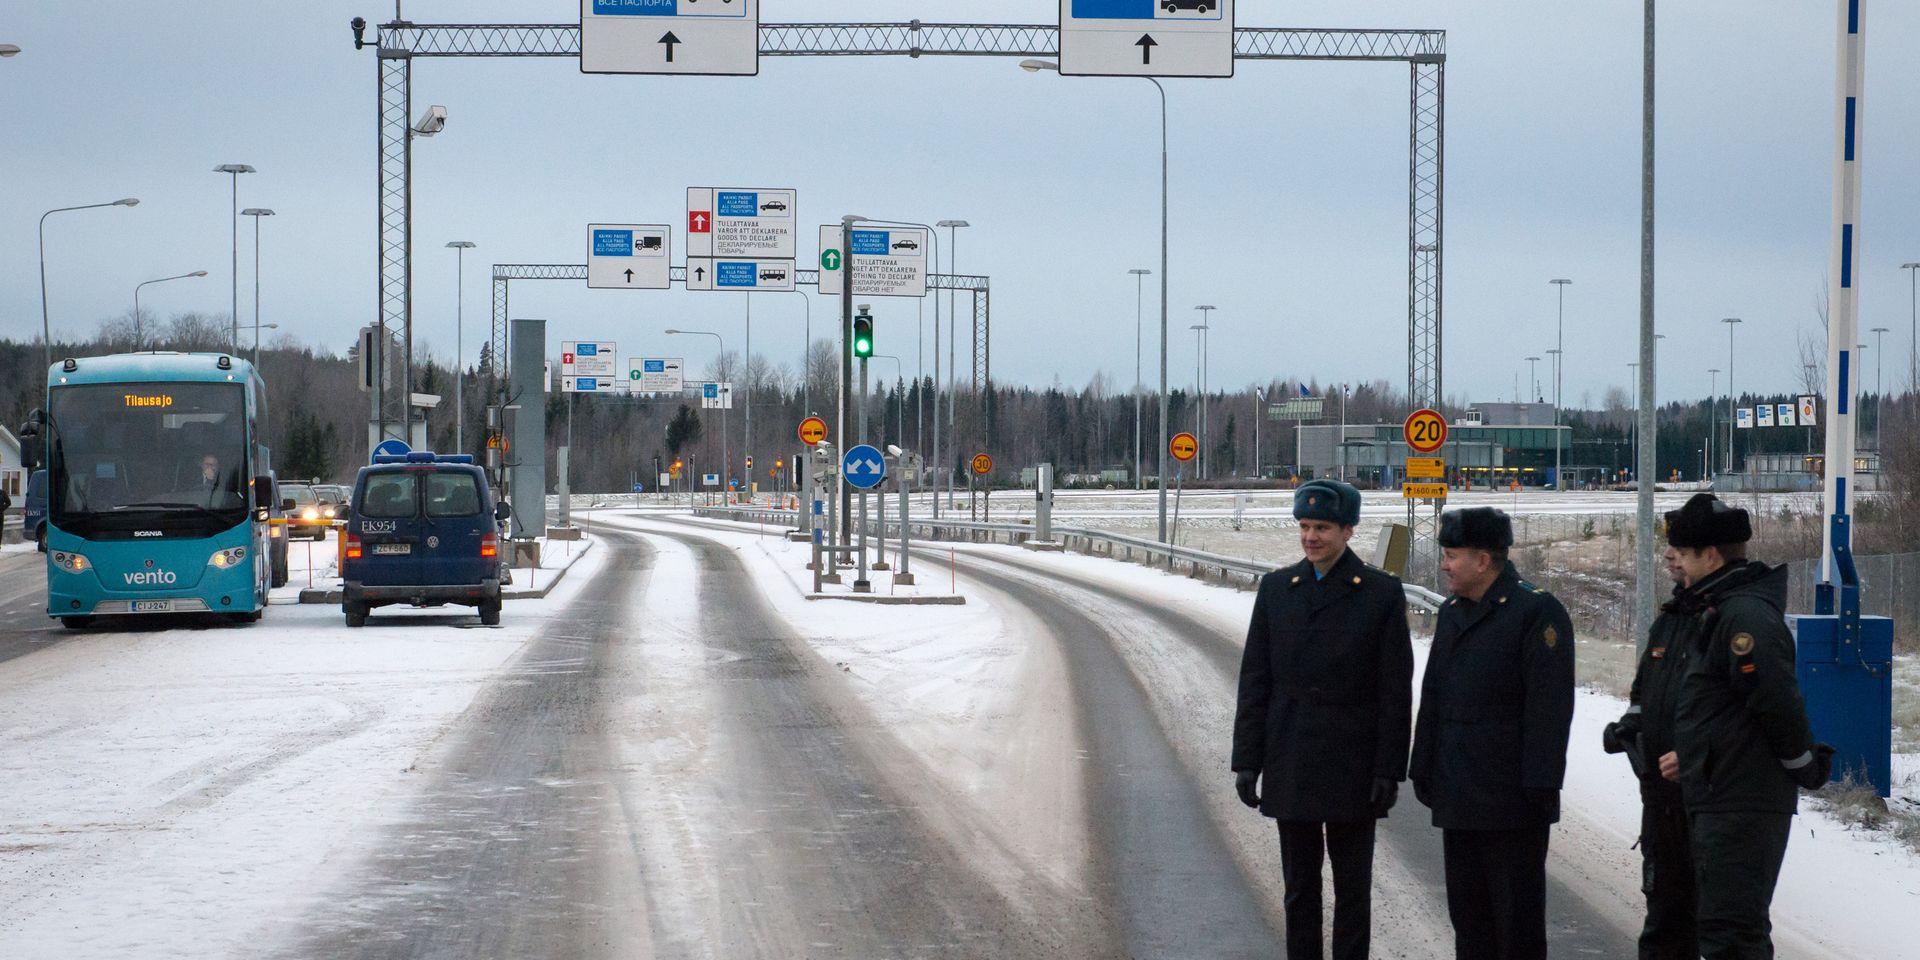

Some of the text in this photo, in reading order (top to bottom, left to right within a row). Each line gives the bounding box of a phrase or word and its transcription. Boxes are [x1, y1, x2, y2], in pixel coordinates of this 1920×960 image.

[124, 395, 172, 408] Tilausajo
[1414, 420, 1440, 441] 20
[976, 459, 988, 469] 30
[362, 521, 396, 531] EK954
[124, 569, 176, 584] vento
